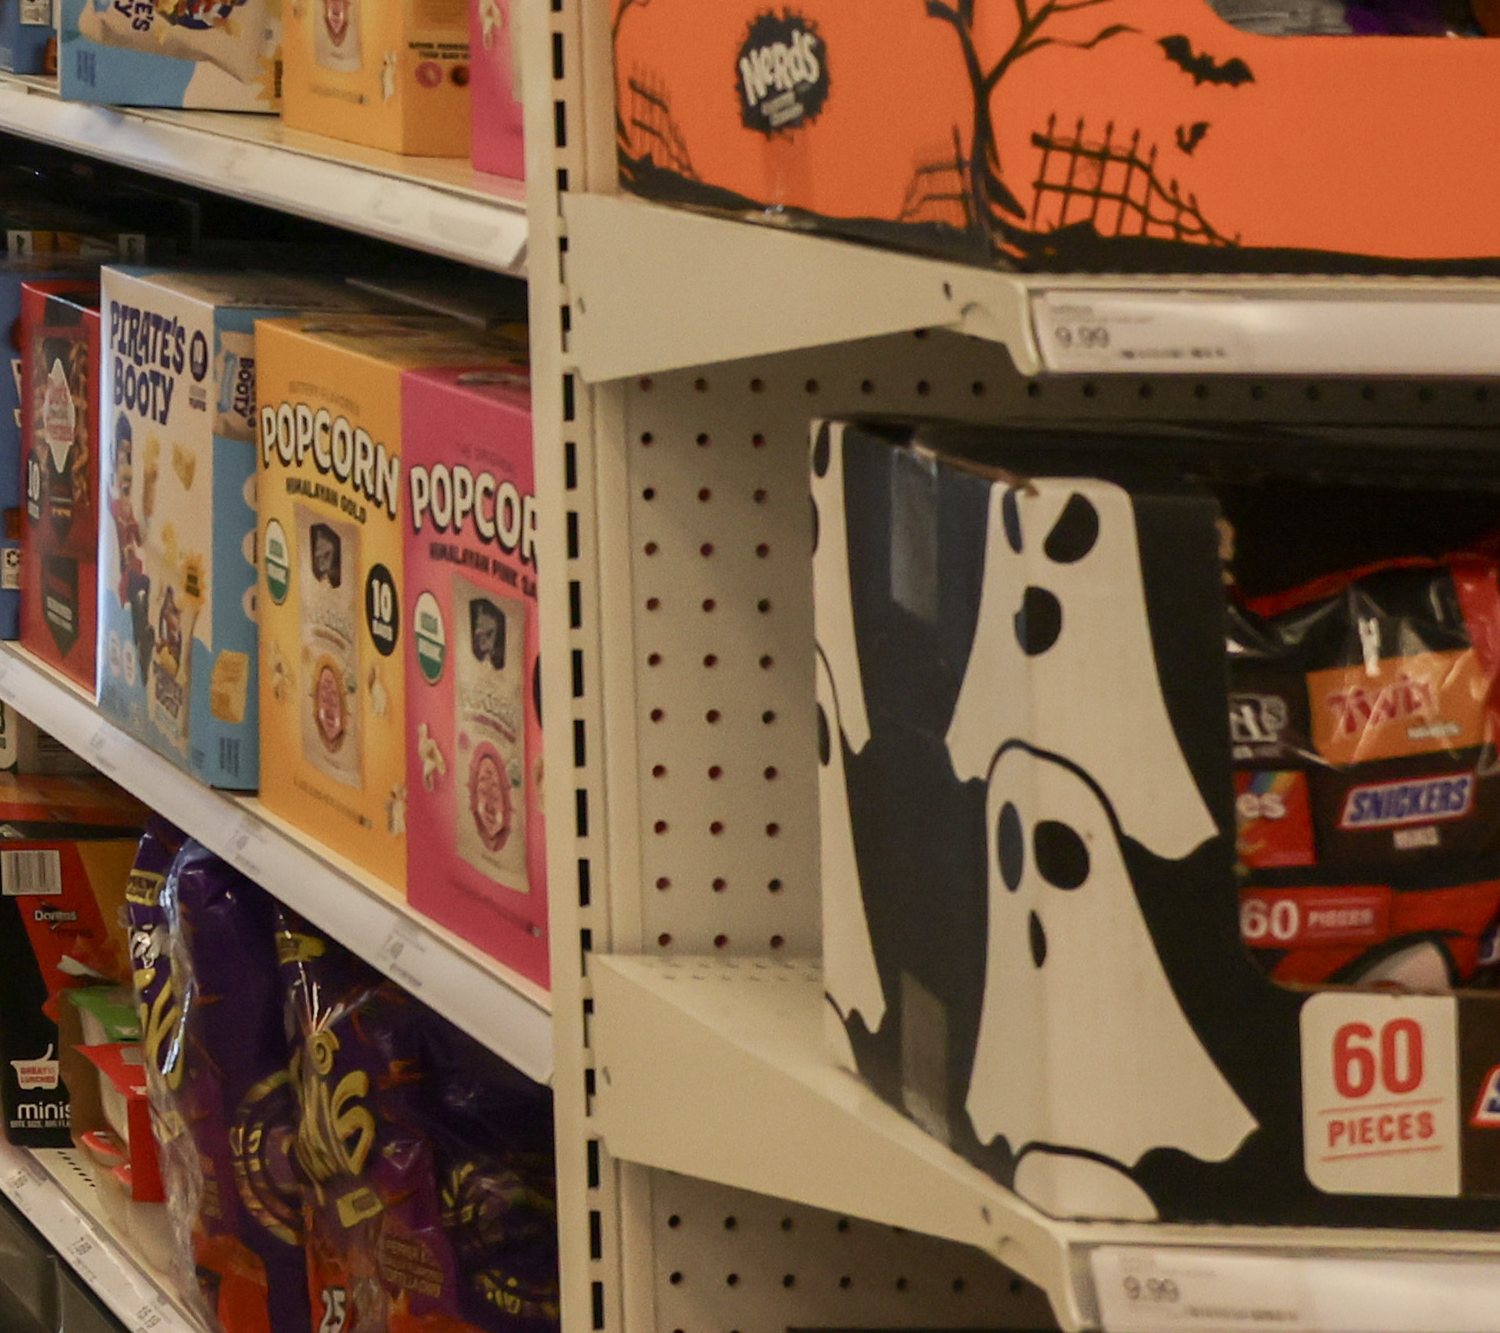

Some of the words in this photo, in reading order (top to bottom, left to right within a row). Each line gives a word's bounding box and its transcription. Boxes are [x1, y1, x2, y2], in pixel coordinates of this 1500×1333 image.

[110, 300, 186, 374] PIRATE'S
[114, 359, 175, 425] BOOTY
[261, 402, 400, 518] POPCORN
[372, 580, 390, 616] 10
[1347, 777, 1471, 823] SNICKERS
[34, 909, 77, 923] Doritos
[1242, 898, 1299, 940] 60
[1333, 1017, 1425, 1099] 60
[1327, 1112, 1435, 1149] PIECES
